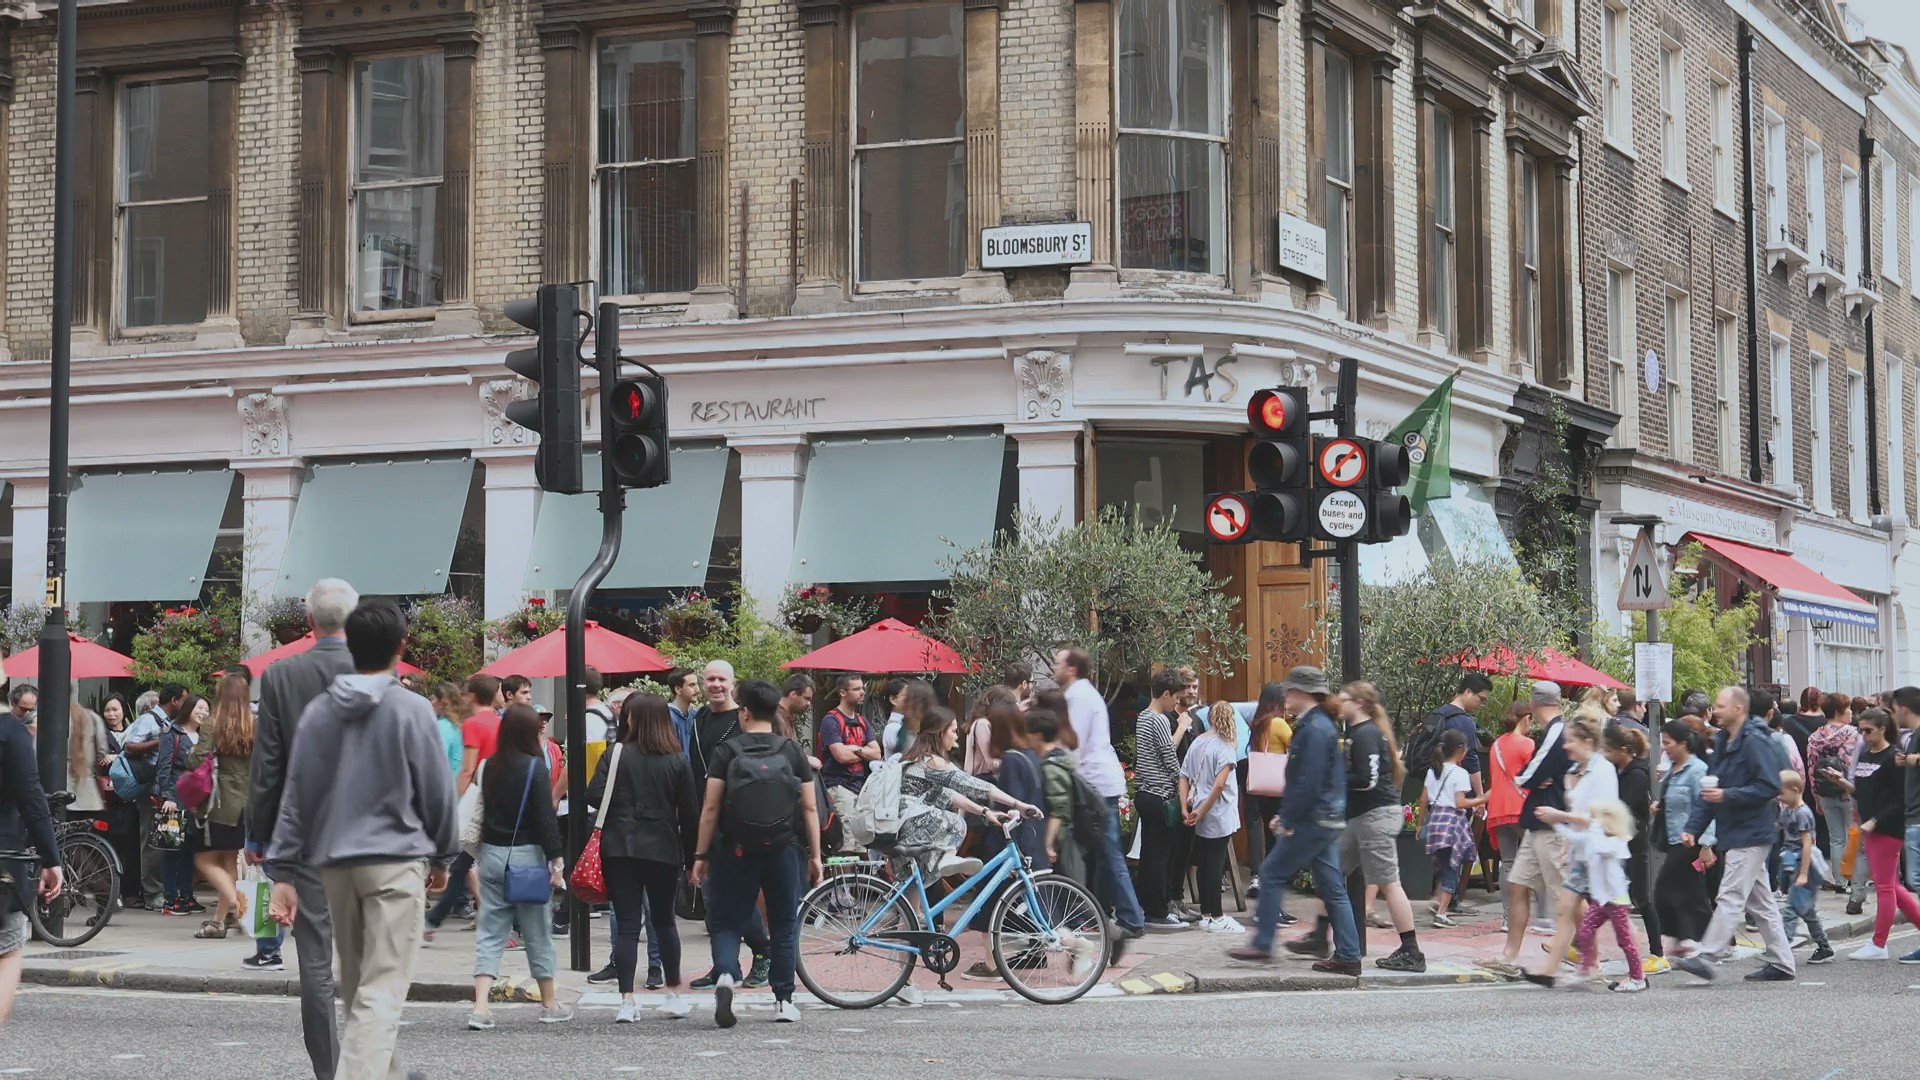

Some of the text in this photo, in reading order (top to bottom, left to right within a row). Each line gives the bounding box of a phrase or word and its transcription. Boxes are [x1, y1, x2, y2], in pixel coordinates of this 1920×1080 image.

[987, 235, 1068, 256] BLOOMSBURY
[1282, 228, 1325, 256] GT RUSSELL
[1283, 247, 1308, 267] STREET
[1150, 354, 1239, 403] TAS
[690, 397, 826, 423] RESTAURANT
[1330, 497, 1357, 509] Except
[1322, 508, 1363, 520] buses and
[1676, 500, 1714, 525] Museum
[1716, 510, 1760, 535] Superstore
[1329, 521, 1354, 531] cycles
